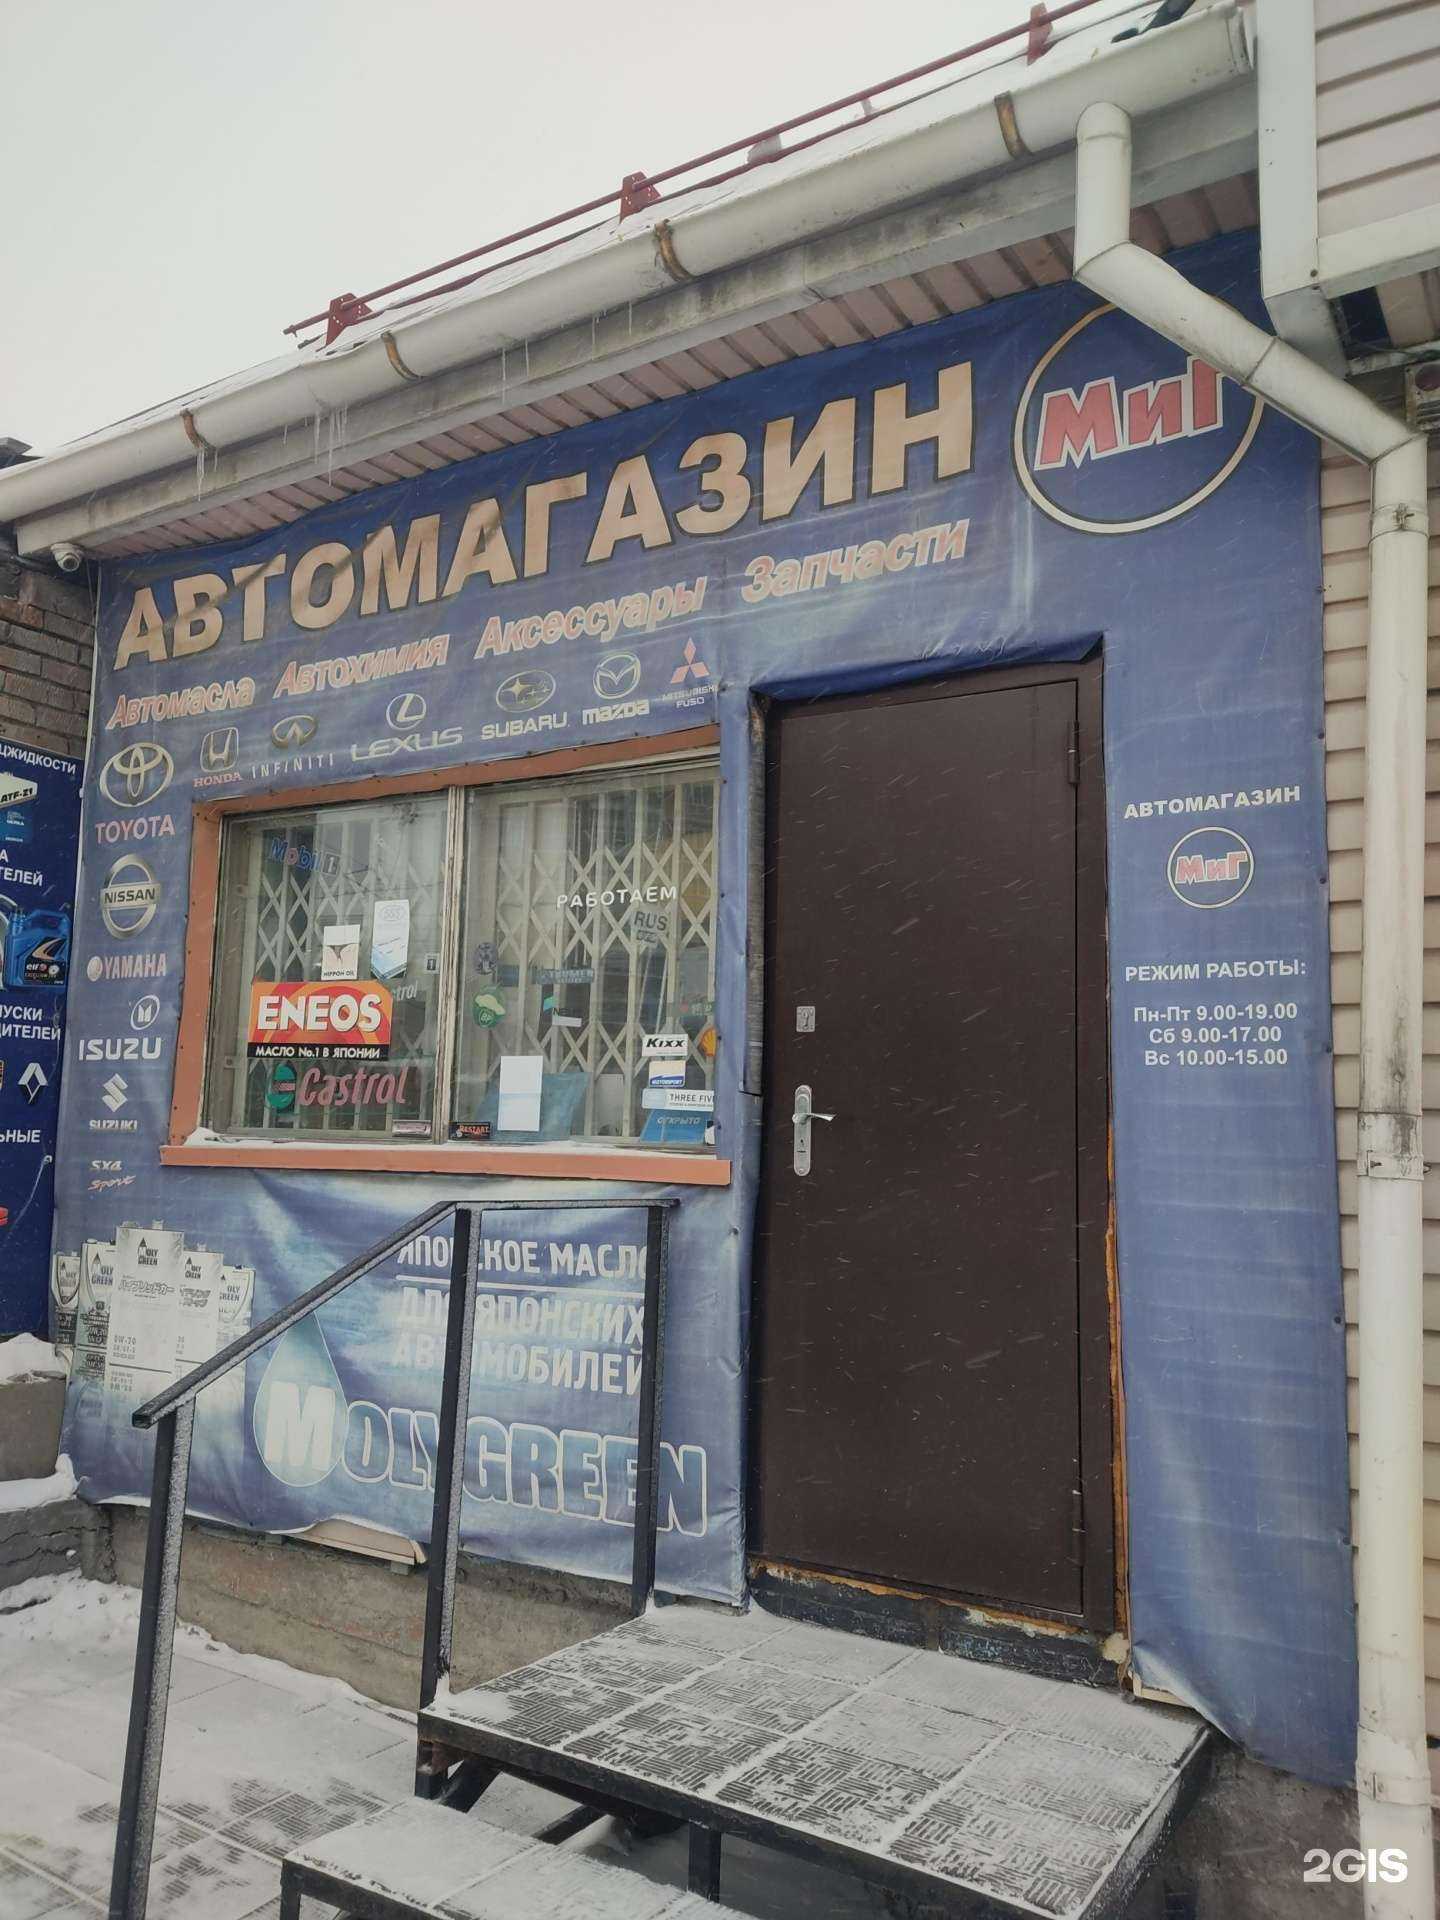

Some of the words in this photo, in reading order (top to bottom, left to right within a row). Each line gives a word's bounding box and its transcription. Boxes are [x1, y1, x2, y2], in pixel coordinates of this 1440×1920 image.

[113, 360, 974, 671] АВТОМАГАЗИН
[106, 676, 256, 730] Автомасла
[273, 633, 450, 699] Автохимия
[473, 576, 708, 659] Аксессуары
[741, 518, 970, 603] Запчасти
[583, 700, 650, 725] mazda
[676, 697, 705, 708] FUSO
[481, 712, 568, 740] SUBARU
[352, 727, 463, 761] LEXUS
[252, 754, 334, 779] INFINITI
[193, 772, 243, 787] HONDA
[1124, 786, 1300, 819] АВТОМАГАЗИН
[95, 814, 175, 844] TOYOTA
[268, 838, 321, 871] Mobil
[1175, 851, 1247, 885] МиГ
[104, 887, 156, 904] NISSAN
[556, 886, 677, 909] РАБОТАЕМ
[634, 911, 668, 931] RUS
[104, 953, 166, 979] YAMAHA
[1125, 964, 1200, 982] РЕЖИМ
[1206, 960, 1306, 979] РАБОТЫ:
[257, 993, 382, 1033] ENEOS
[1134, 1006, 1190, 1023] Пн-Пт
[1196, 1003, 1297, 1021] 9.00-19.00
[0, 1023, 61, 1041] ИТЕЛЕЙ
[646, 1038, 685, 1048] Kixx
[1149, 1028, 1175, 1043] Сб
[1181, 1026, 1281, 1043] 9.00-17.00
[79, 1037, 162, 1060] ISUZU
[255, 1047, 294, 1058] МАСЛО
[298, 1047, 320, 1058] No.1
[322, 1048, 329, 1058] В
[333, 1047, 380, 1058] ЯПОНИИ
[1145, 1050, 1170, 1066] Вс
[1176, 1048, 1288, 1066] 10.00-15.00
[300, 1065, 409, 1107] Castrol
[670, 1093, 697, 1102] THREE
[89, 1119, 138, 1131] SUZUKI
[657, 1115, 700, 1125] ОТКРЫТО
[91, 1160, 122, 1171] SX4
[398, 1235, 541, 1274] ЯПОКОЕ
[402, 1286, 451, 1329] ДЛ
[390, 1333, 643, 1396] АВМОБИЛЕЙ
